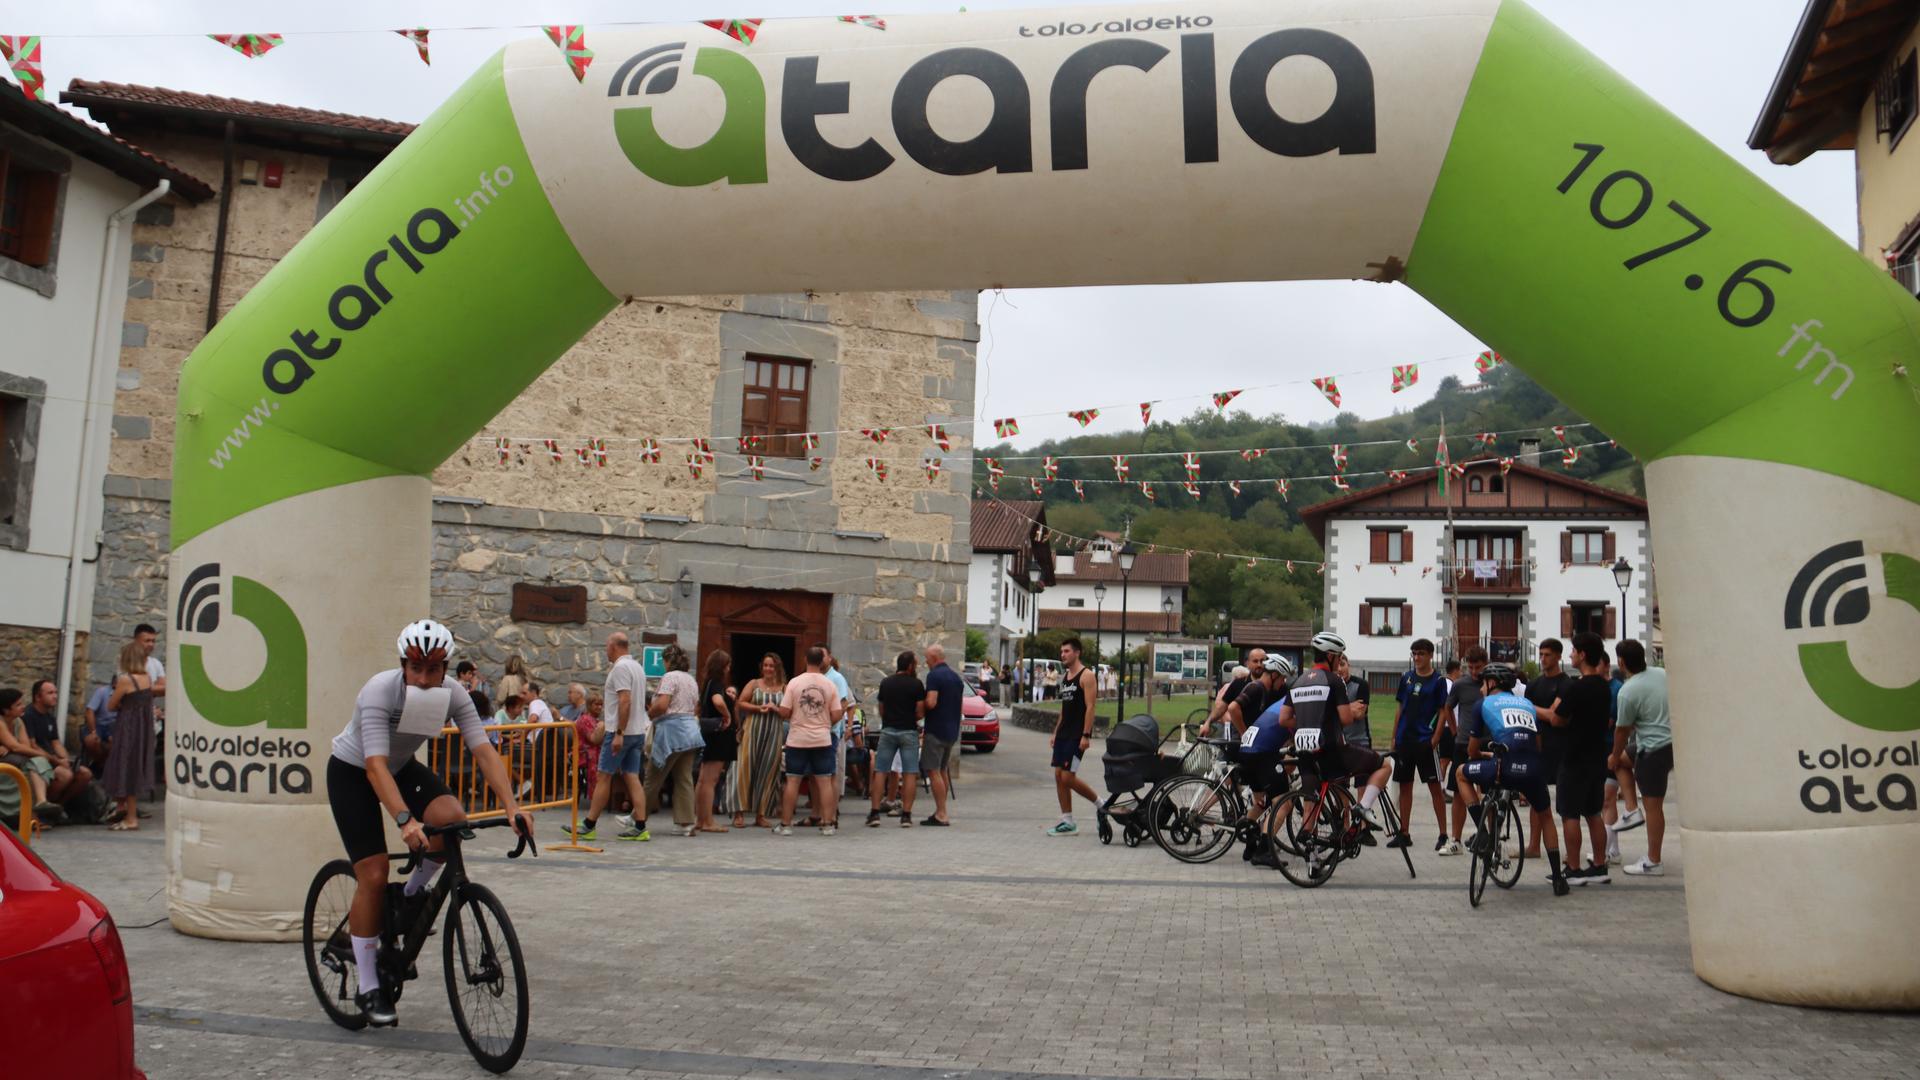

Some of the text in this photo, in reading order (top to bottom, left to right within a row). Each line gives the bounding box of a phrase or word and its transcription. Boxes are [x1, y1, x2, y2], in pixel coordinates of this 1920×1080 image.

[1019, 15, 1213, 38] tolosaldeko
[608, 27, 1377, 187] ataria
[1556, 142, 1855, 401] 107.6 fm
[1506, 713, 1534, 729] 062
[175, 731, 312, 759] tolosaldeko
[174, 754, 312, 794] ataria
[1800, 773, 1918, 813] ata
